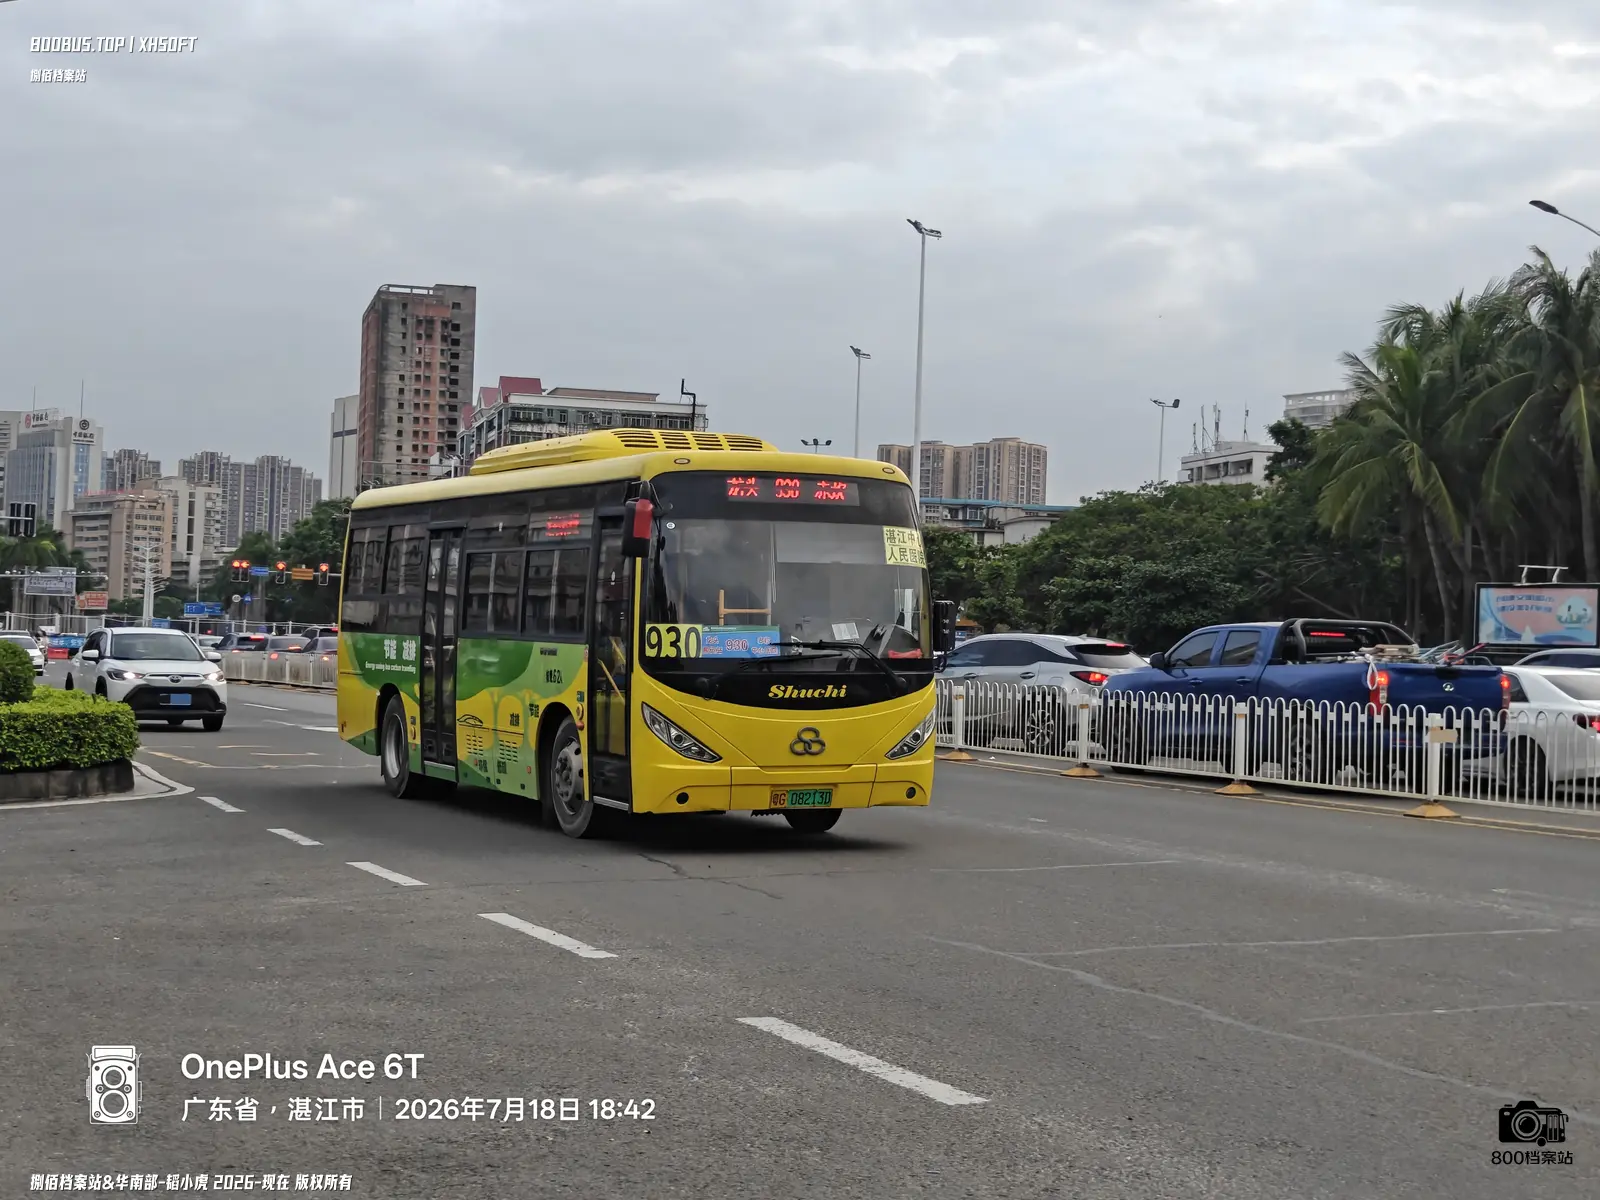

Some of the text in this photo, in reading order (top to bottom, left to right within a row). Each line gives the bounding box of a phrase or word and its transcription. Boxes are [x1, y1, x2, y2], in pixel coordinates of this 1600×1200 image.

[775, 478, 801, 498] 930
[888, 547, 926, 565] 人民医院
[646, 625, 702, 658] 930
[726, 638, 749, 651] 930
[768, 684, 848, 699] Shuchi
